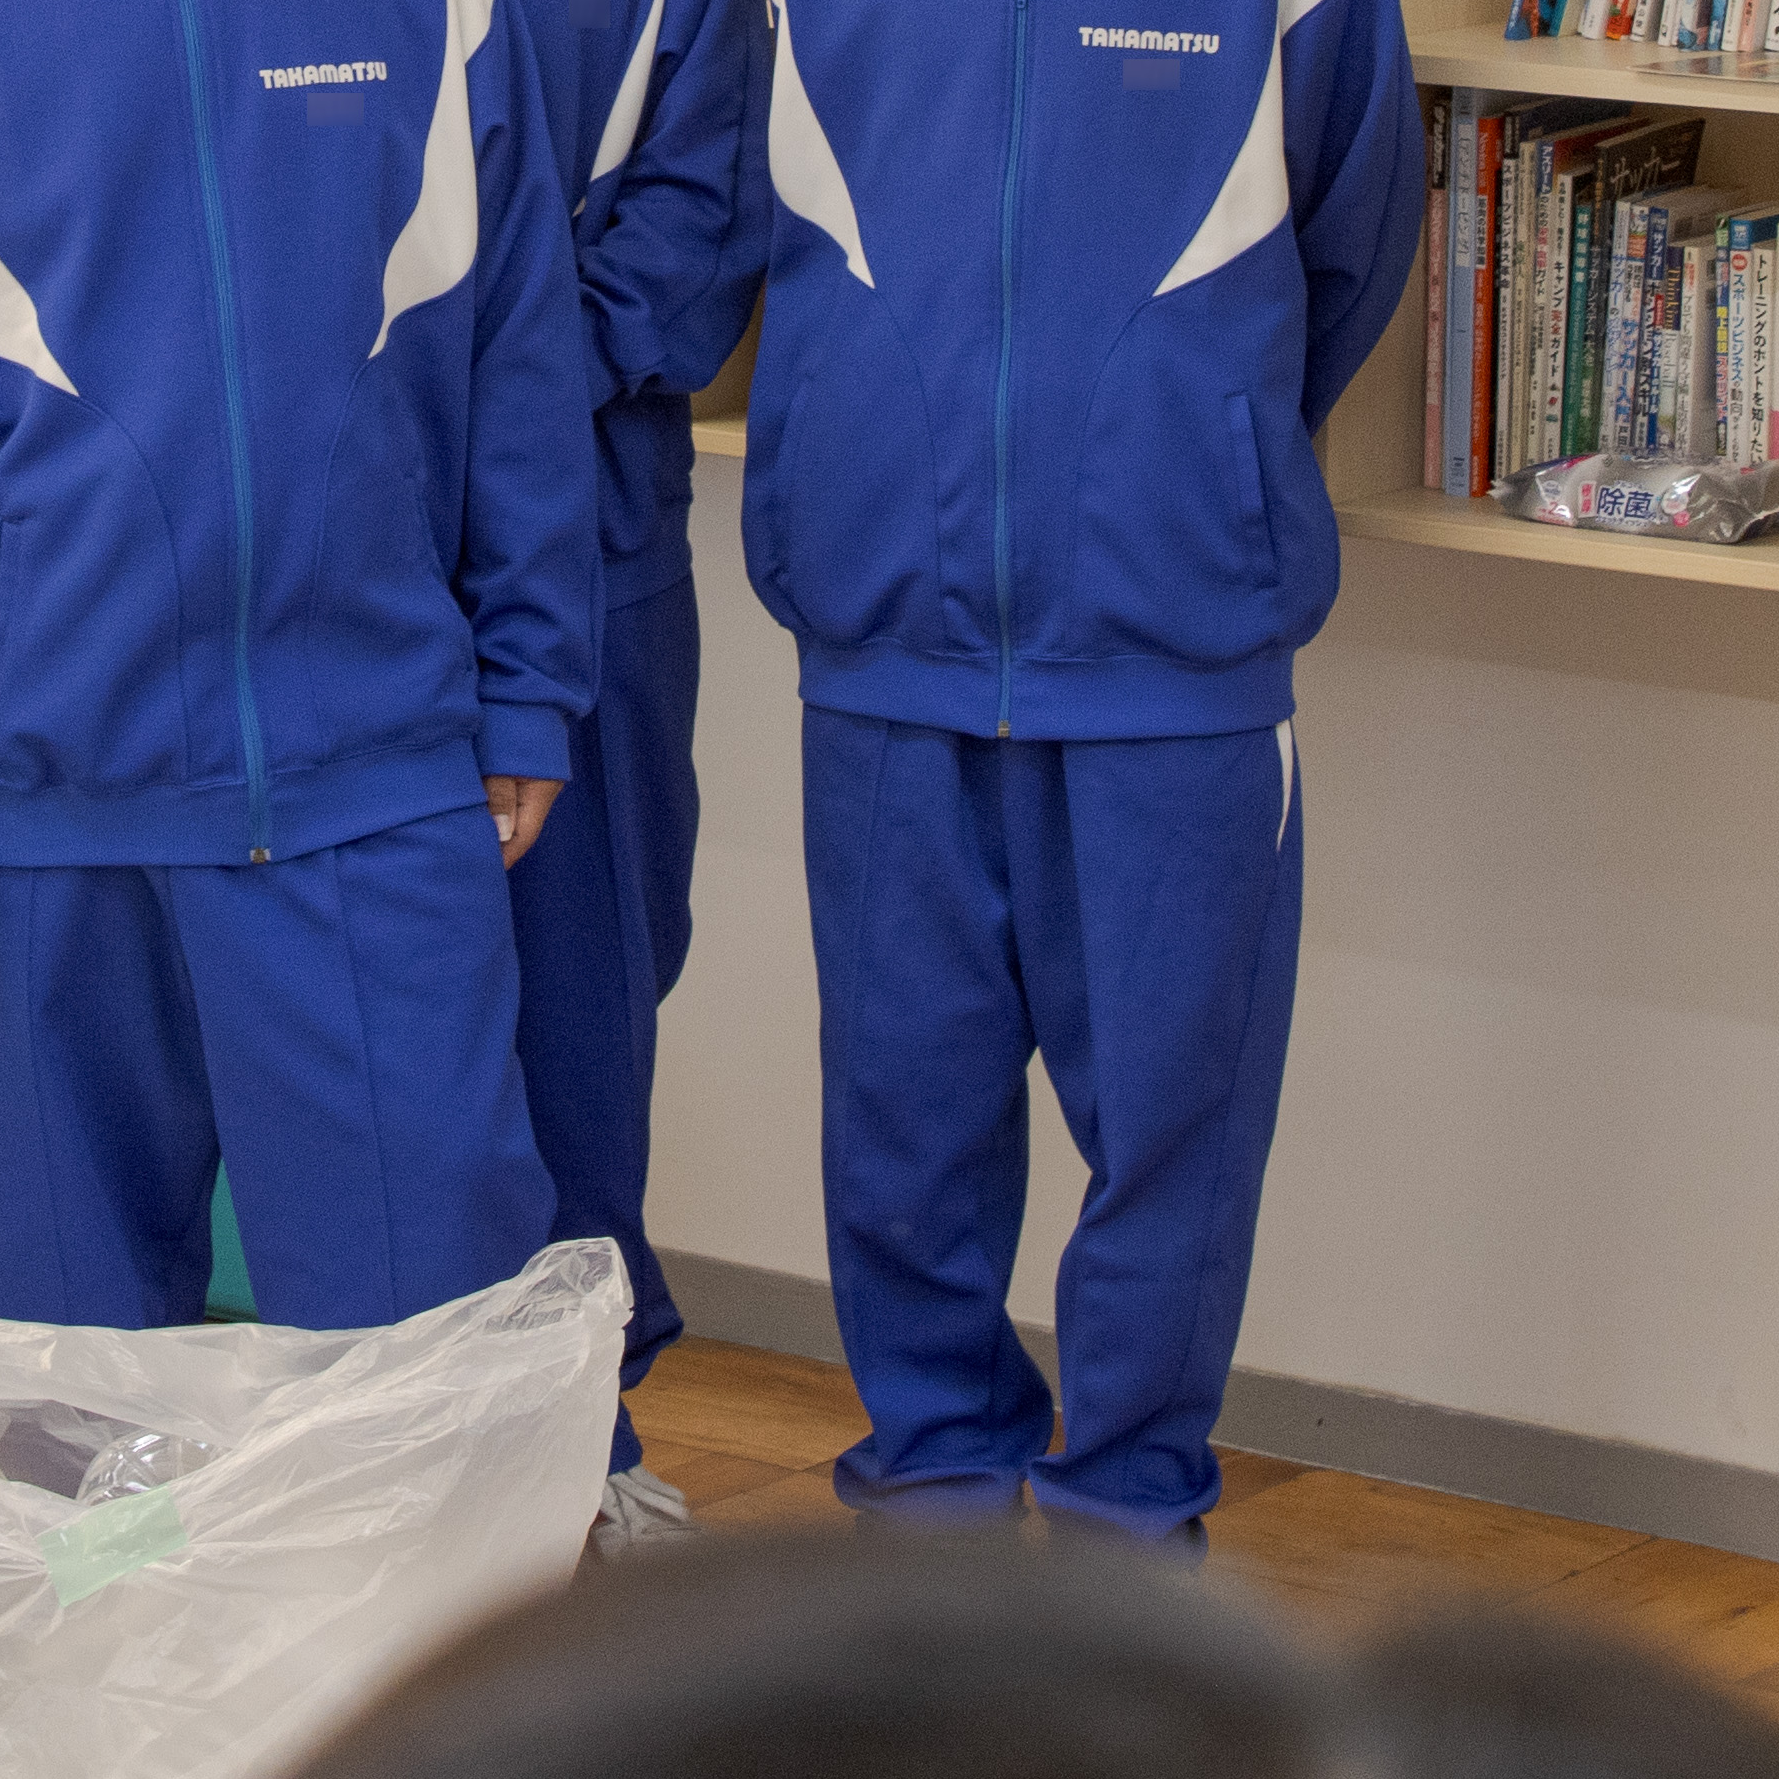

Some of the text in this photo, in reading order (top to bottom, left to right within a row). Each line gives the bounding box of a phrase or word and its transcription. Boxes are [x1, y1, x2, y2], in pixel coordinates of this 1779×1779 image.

[1077, 27, 1220, 54] TAKAMATSU
[259, 61, 387, 89] TAKAMATSU
[1597, 486, 1655, 519] 除菌
